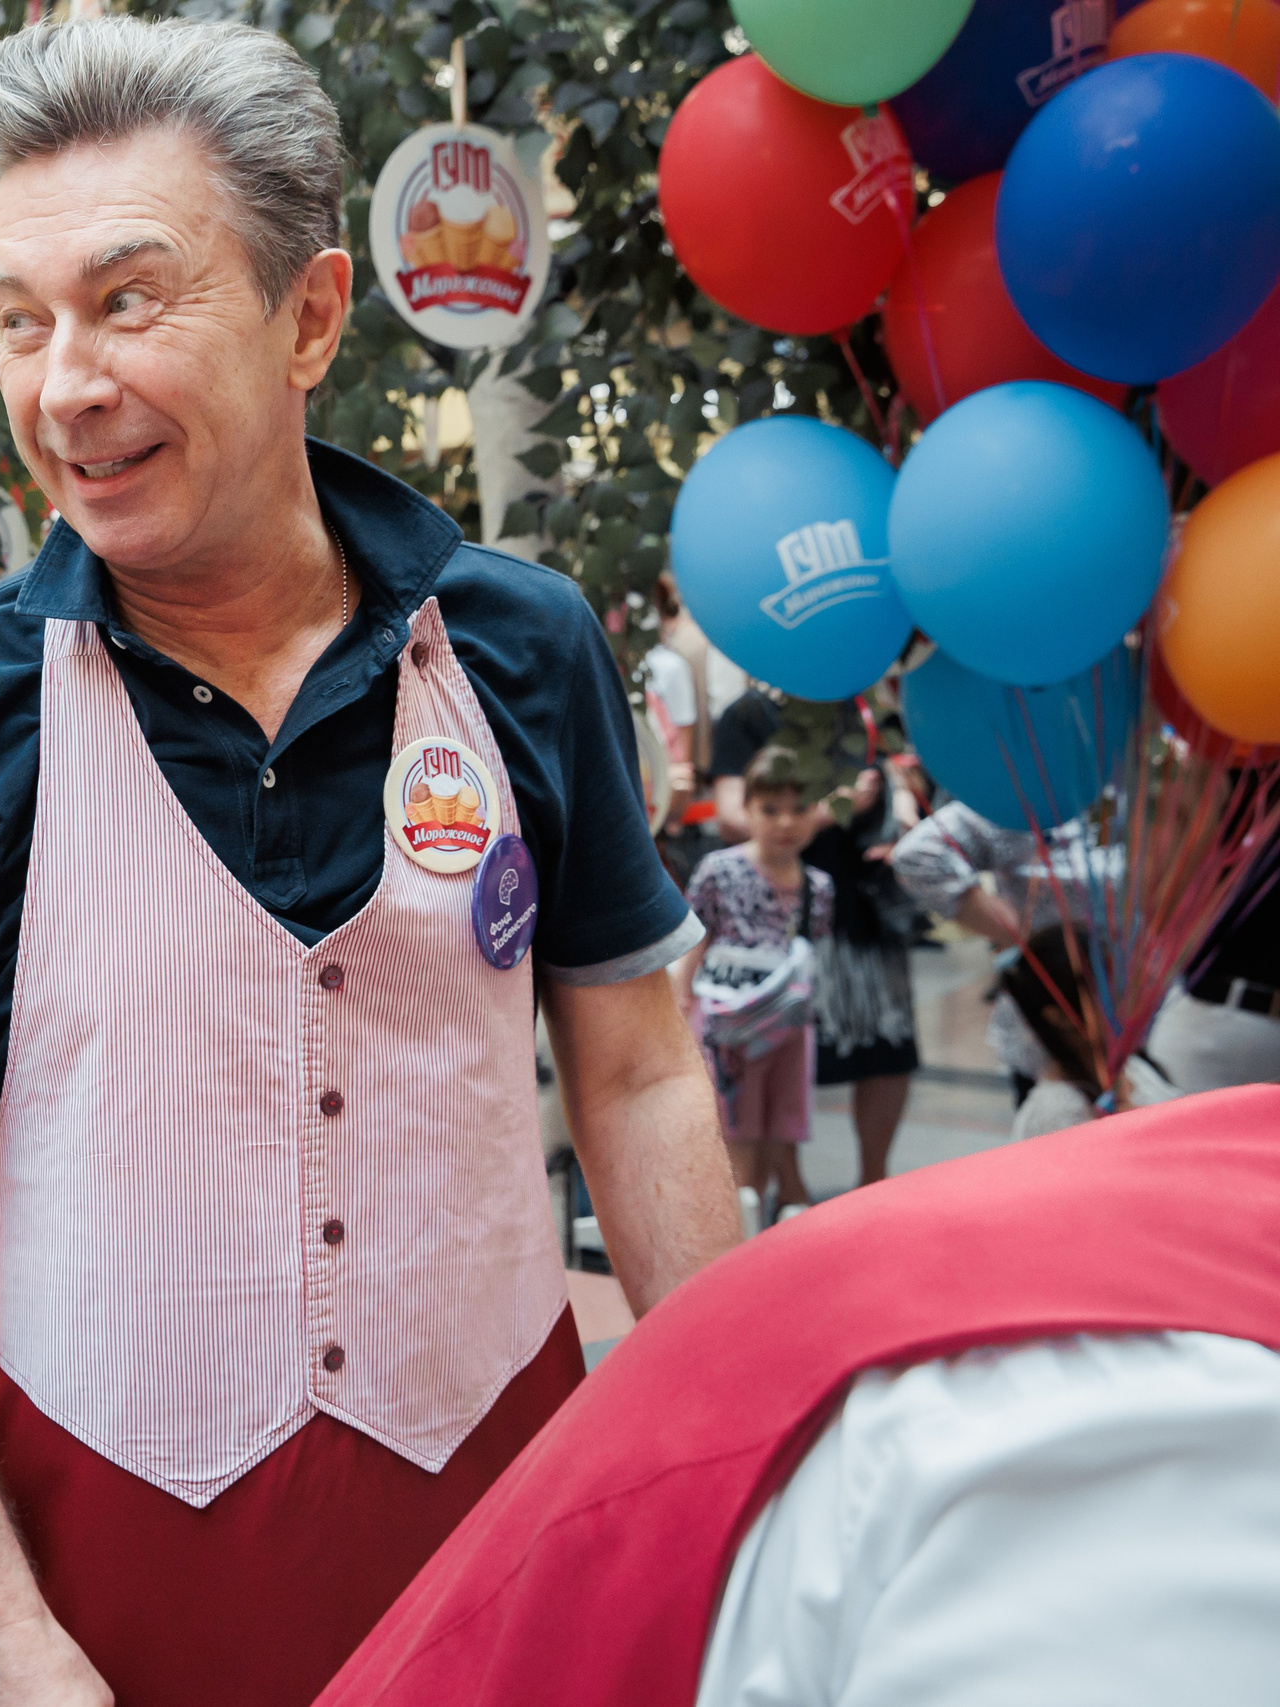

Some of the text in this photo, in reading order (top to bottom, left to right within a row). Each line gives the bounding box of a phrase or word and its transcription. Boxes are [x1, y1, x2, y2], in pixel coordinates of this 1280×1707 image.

[432, 141, 491, 194] ГУМ
[776, 518, 864, 585] ГУМ
[423, 747, 463, 780] ГУМ
[412, 826, 485, 847] Мороженое
[489, 911, 513, 936] Фонд
[492, 903, 538, 953] Хабенского
